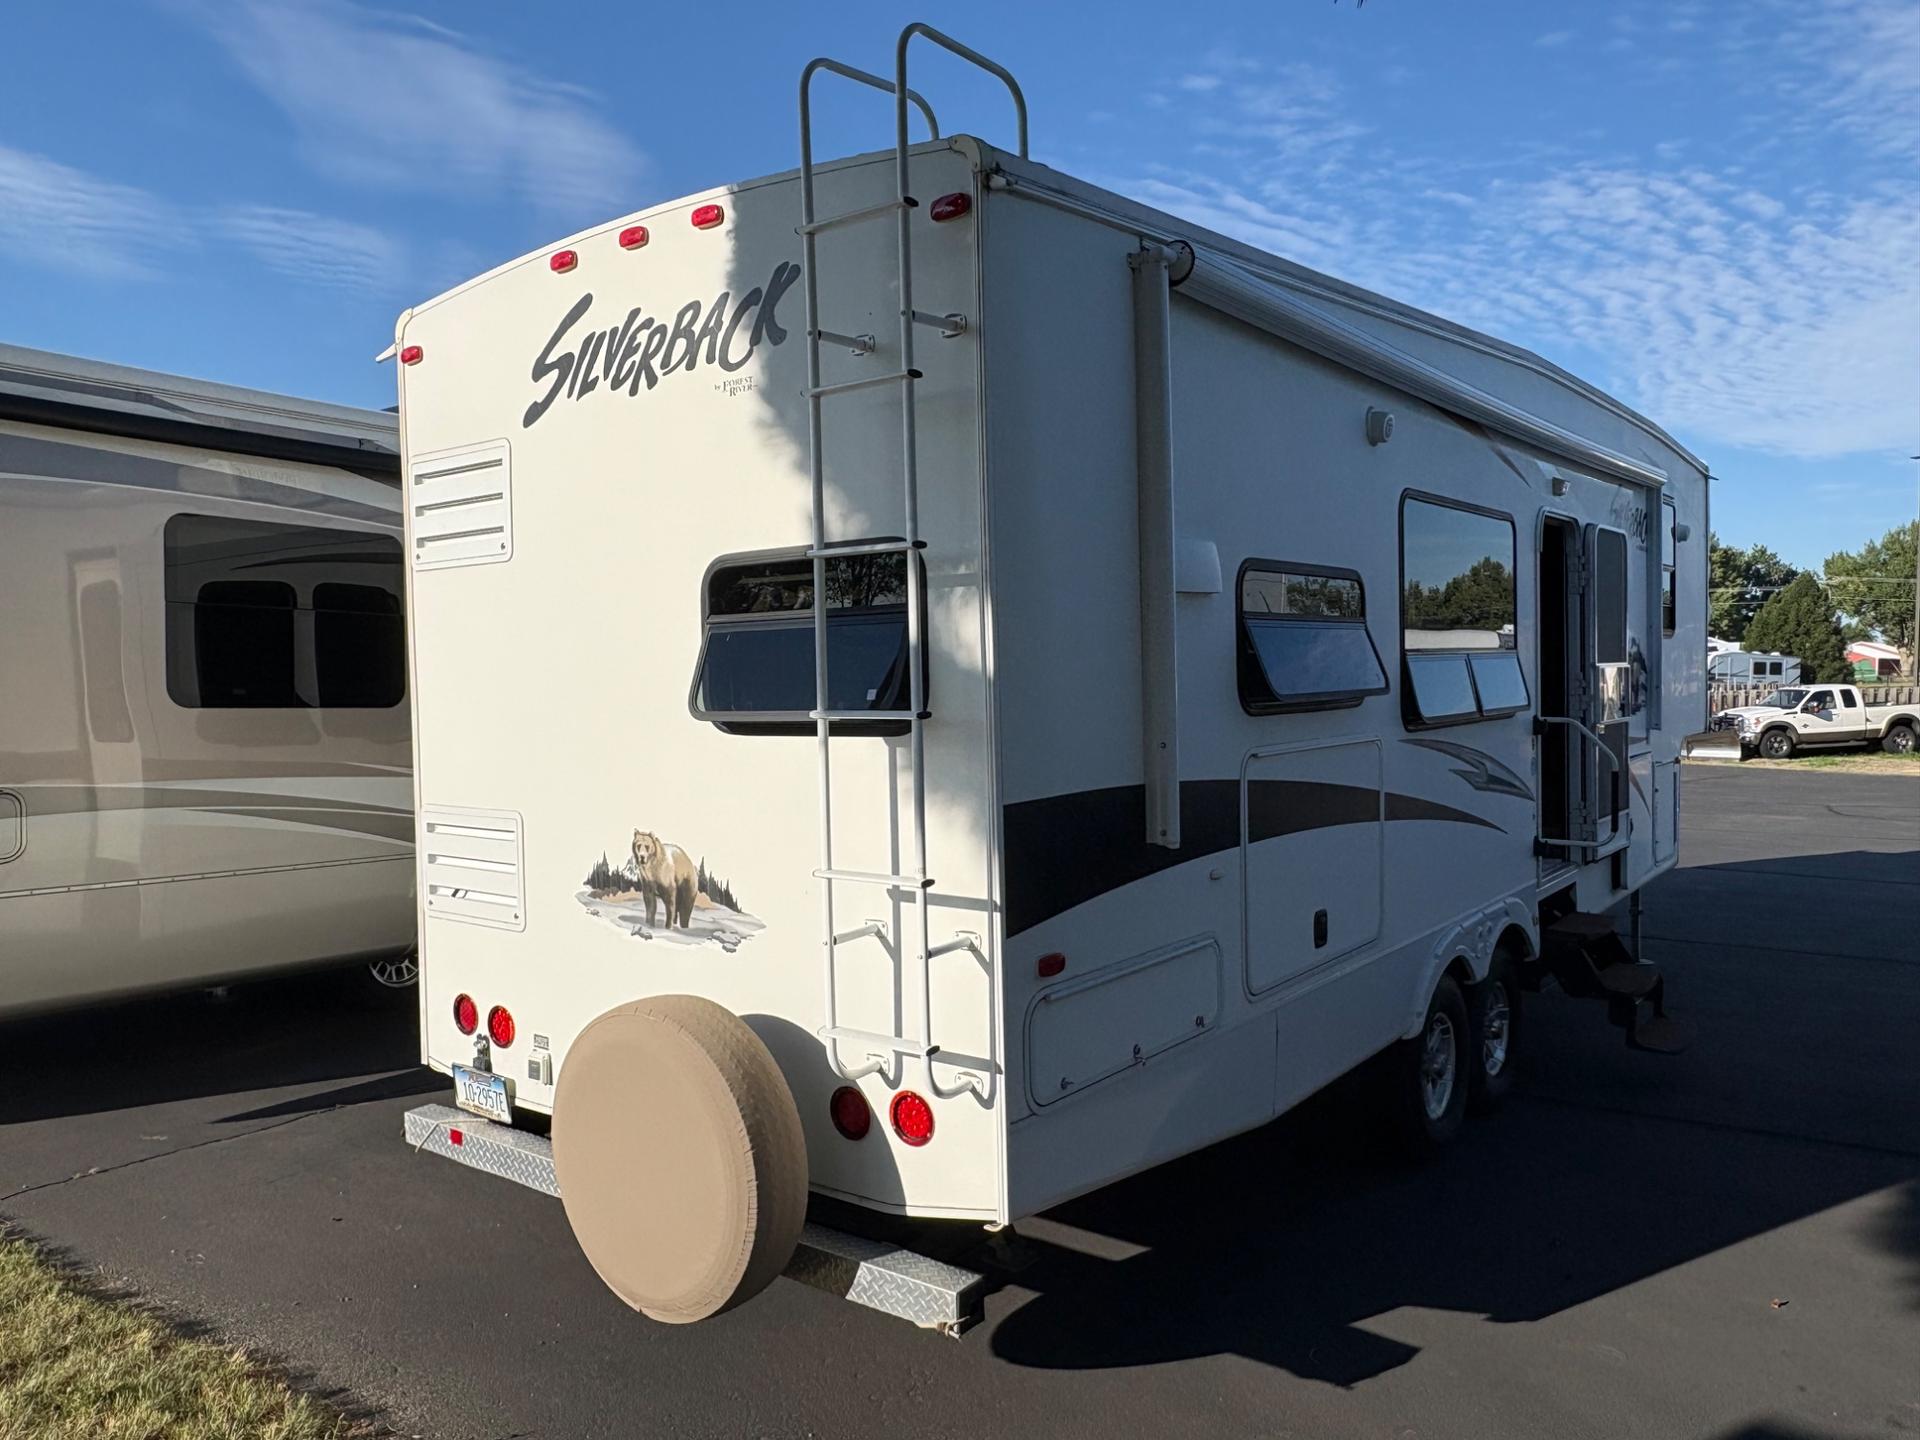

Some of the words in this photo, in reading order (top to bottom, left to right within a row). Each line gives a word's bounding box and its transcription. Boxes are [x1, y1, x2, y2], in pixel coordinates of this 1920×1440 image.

[522, 261, 801, 429] SILVERBACK
[723, 376, 753, 392] FOREST
[729, 384, 753, 397] RIVER
